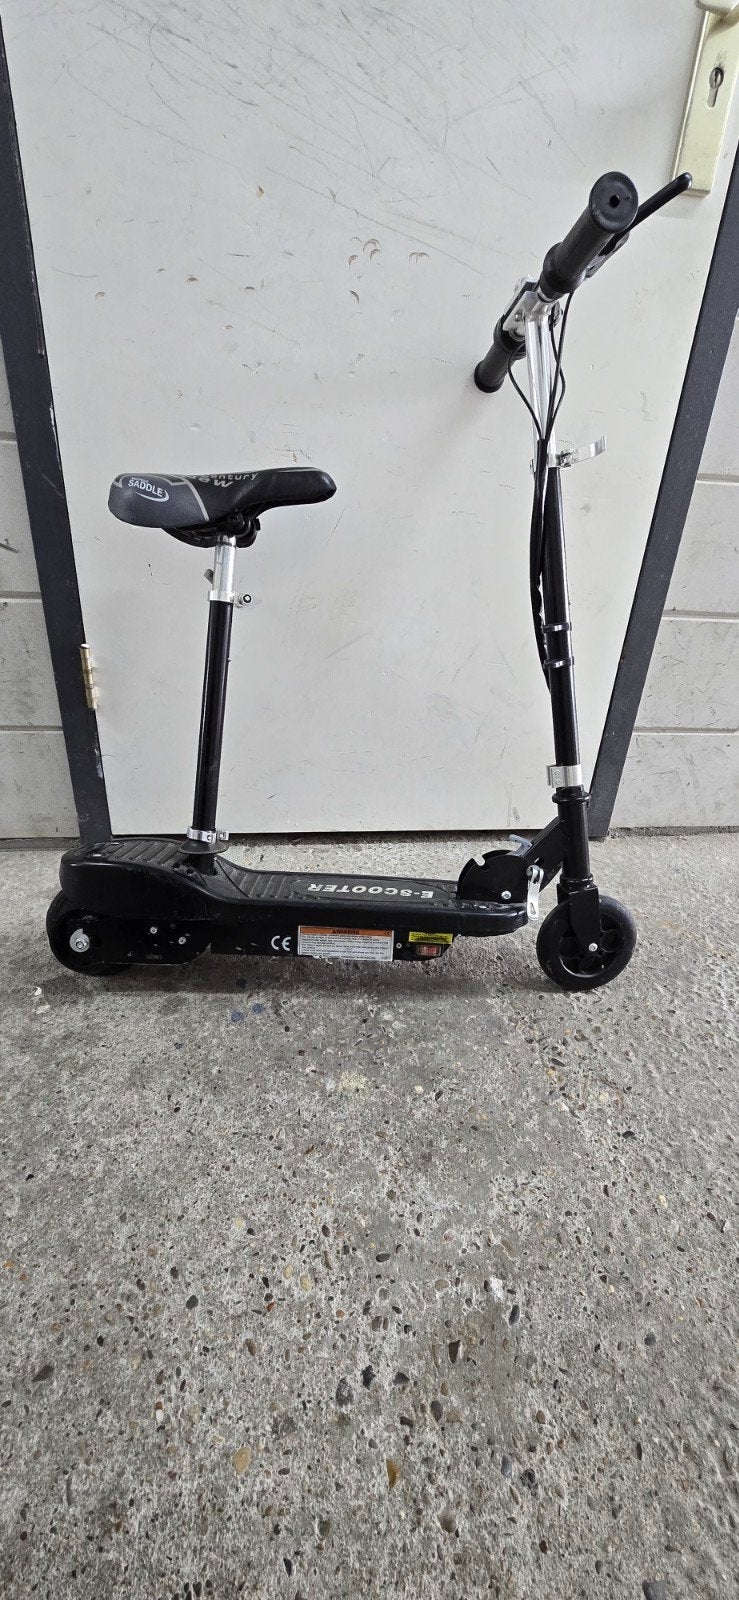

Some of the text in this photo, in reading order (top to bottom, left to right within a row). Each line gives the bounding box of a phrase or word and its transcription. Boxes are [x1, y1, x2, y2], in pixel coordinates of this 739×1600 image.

[128, 479, 164, 498] SADDLE
[308, 883, 434, 899] E-SCOOTER
[271, 935, 291, 952] CE
